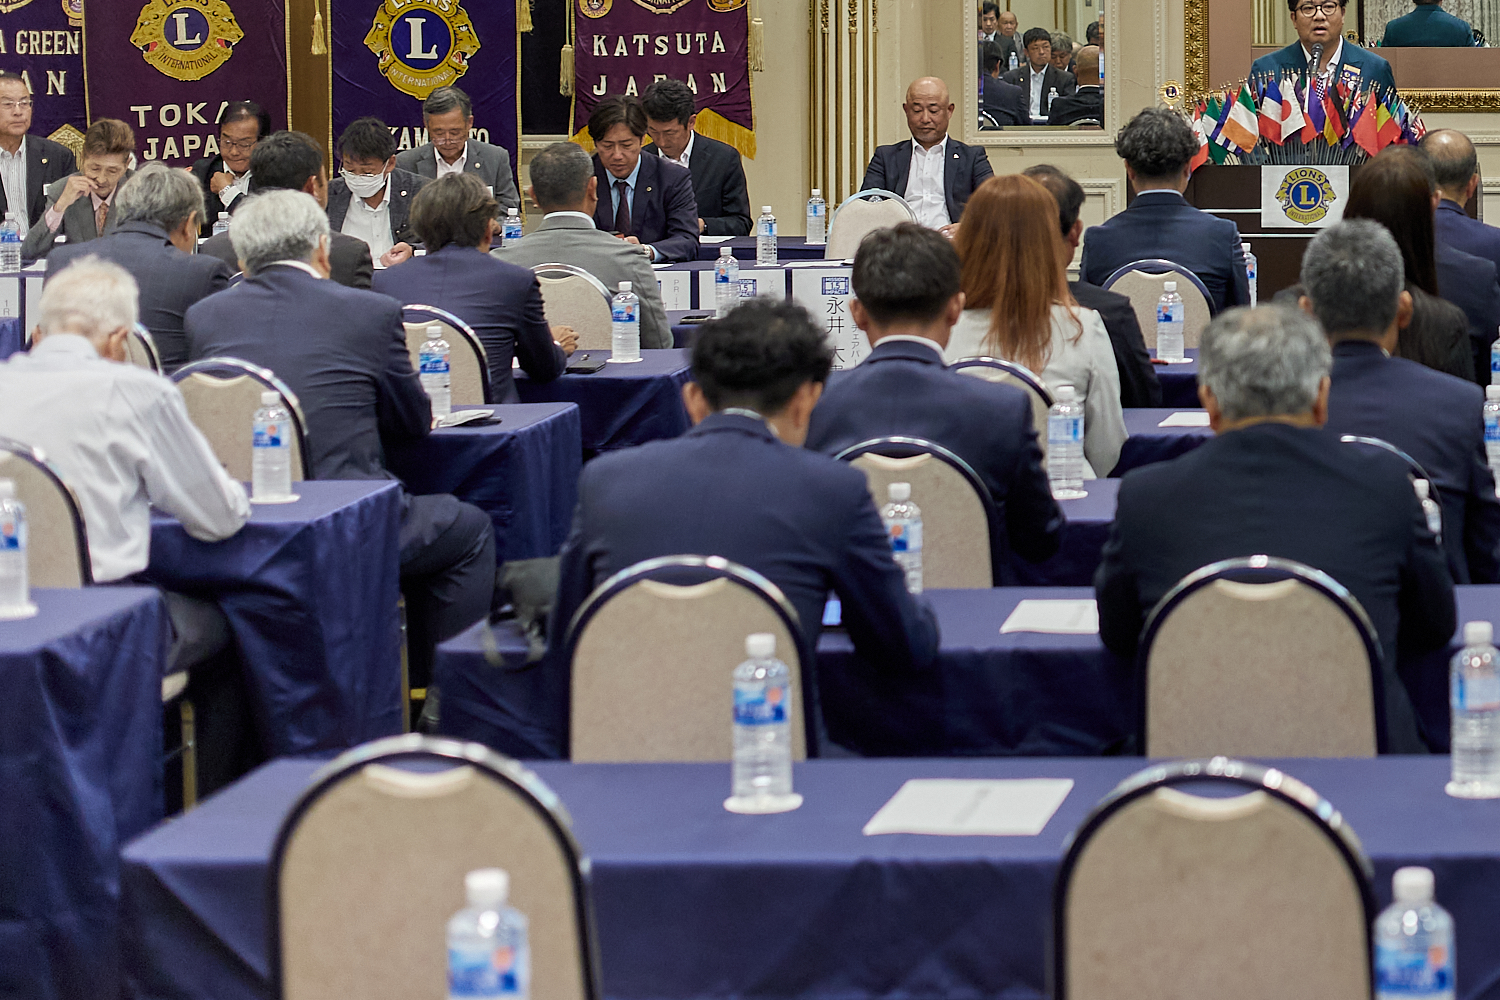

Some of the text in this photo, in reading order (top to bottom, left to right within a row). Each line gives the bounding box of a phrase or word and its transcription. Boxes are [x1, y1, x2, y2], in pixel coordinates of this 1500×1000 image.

[15, 29, 80, 55] GREEN
[172, 12, 202, 46] L
[404, 17, 439, 60] L
[592, 30, 726, 57] KATSUTA
[158, 51, 218, 70] INTERNATIONAL
[390, 66, 454, 87] INTERNATIONAL
[129, 100, 229, 128] TOK
[143, 134, 221, 161] JAPA
[1288, 170, 1323, 182] LIONS
[1299, 185, 1315, 205] L
[1289, 210, 1323, 220] INTERNATIONAL
[826, 296, 845, 333] 永井
